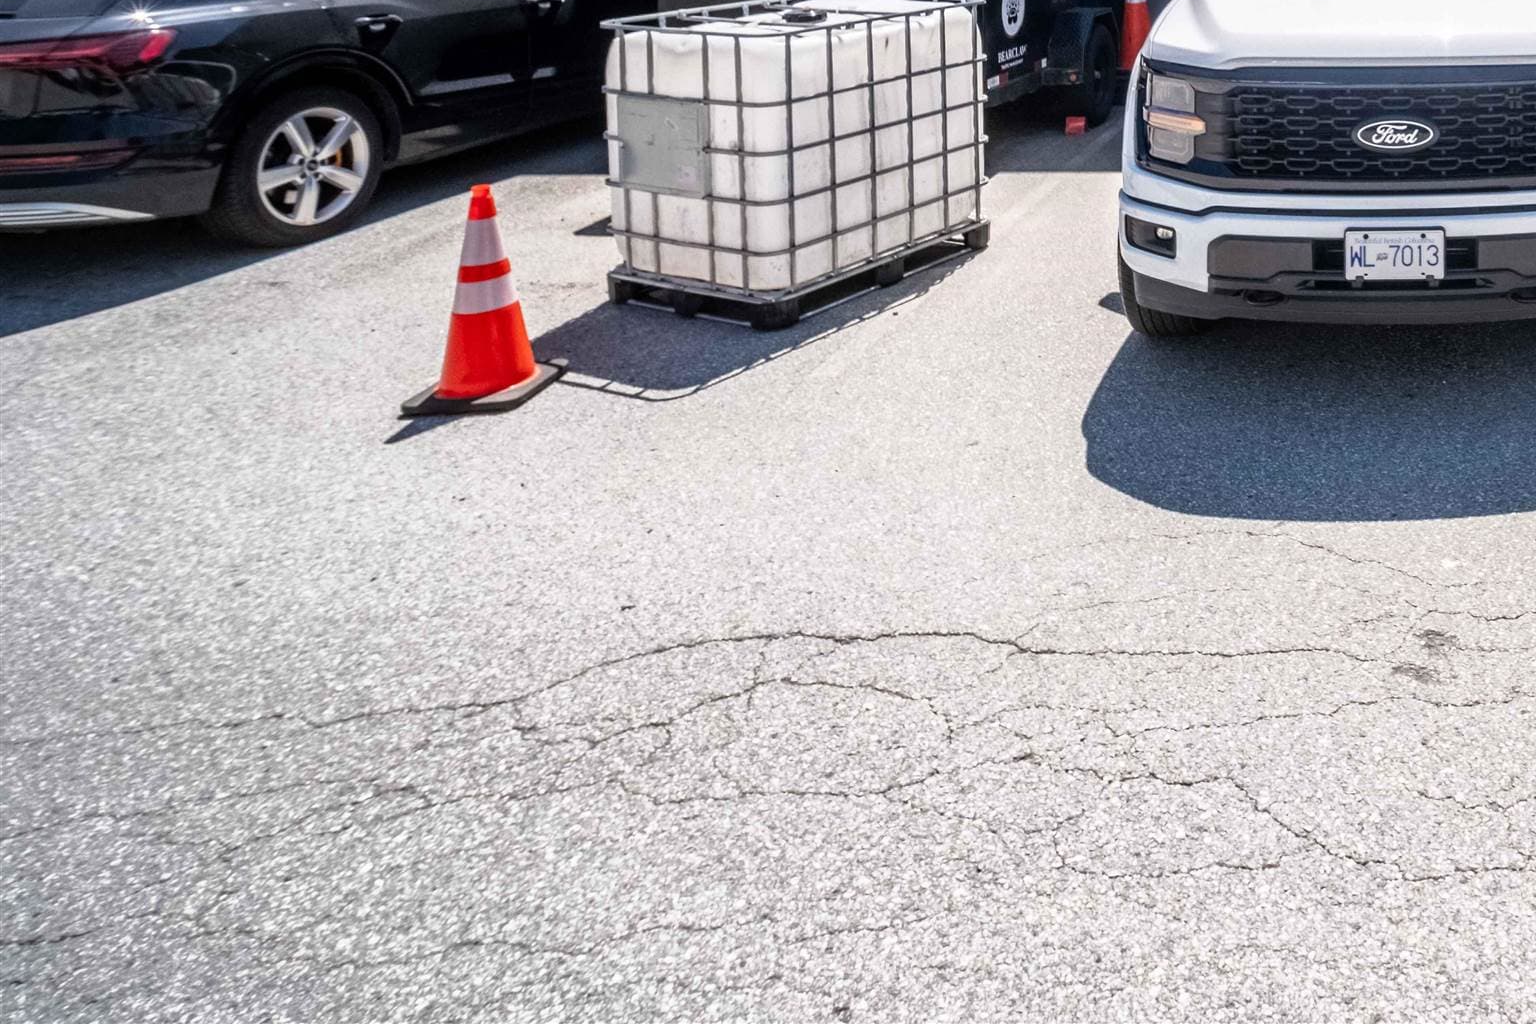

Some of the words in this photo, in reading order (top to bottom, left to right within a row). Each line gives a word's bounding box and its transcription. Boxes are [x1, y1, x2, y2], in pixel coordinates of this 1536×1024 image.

[1371, 124, 1419, 144] Ford
[1350, 245, 1375, 267] WL
[1389, 244, 1439, 267] 7013
